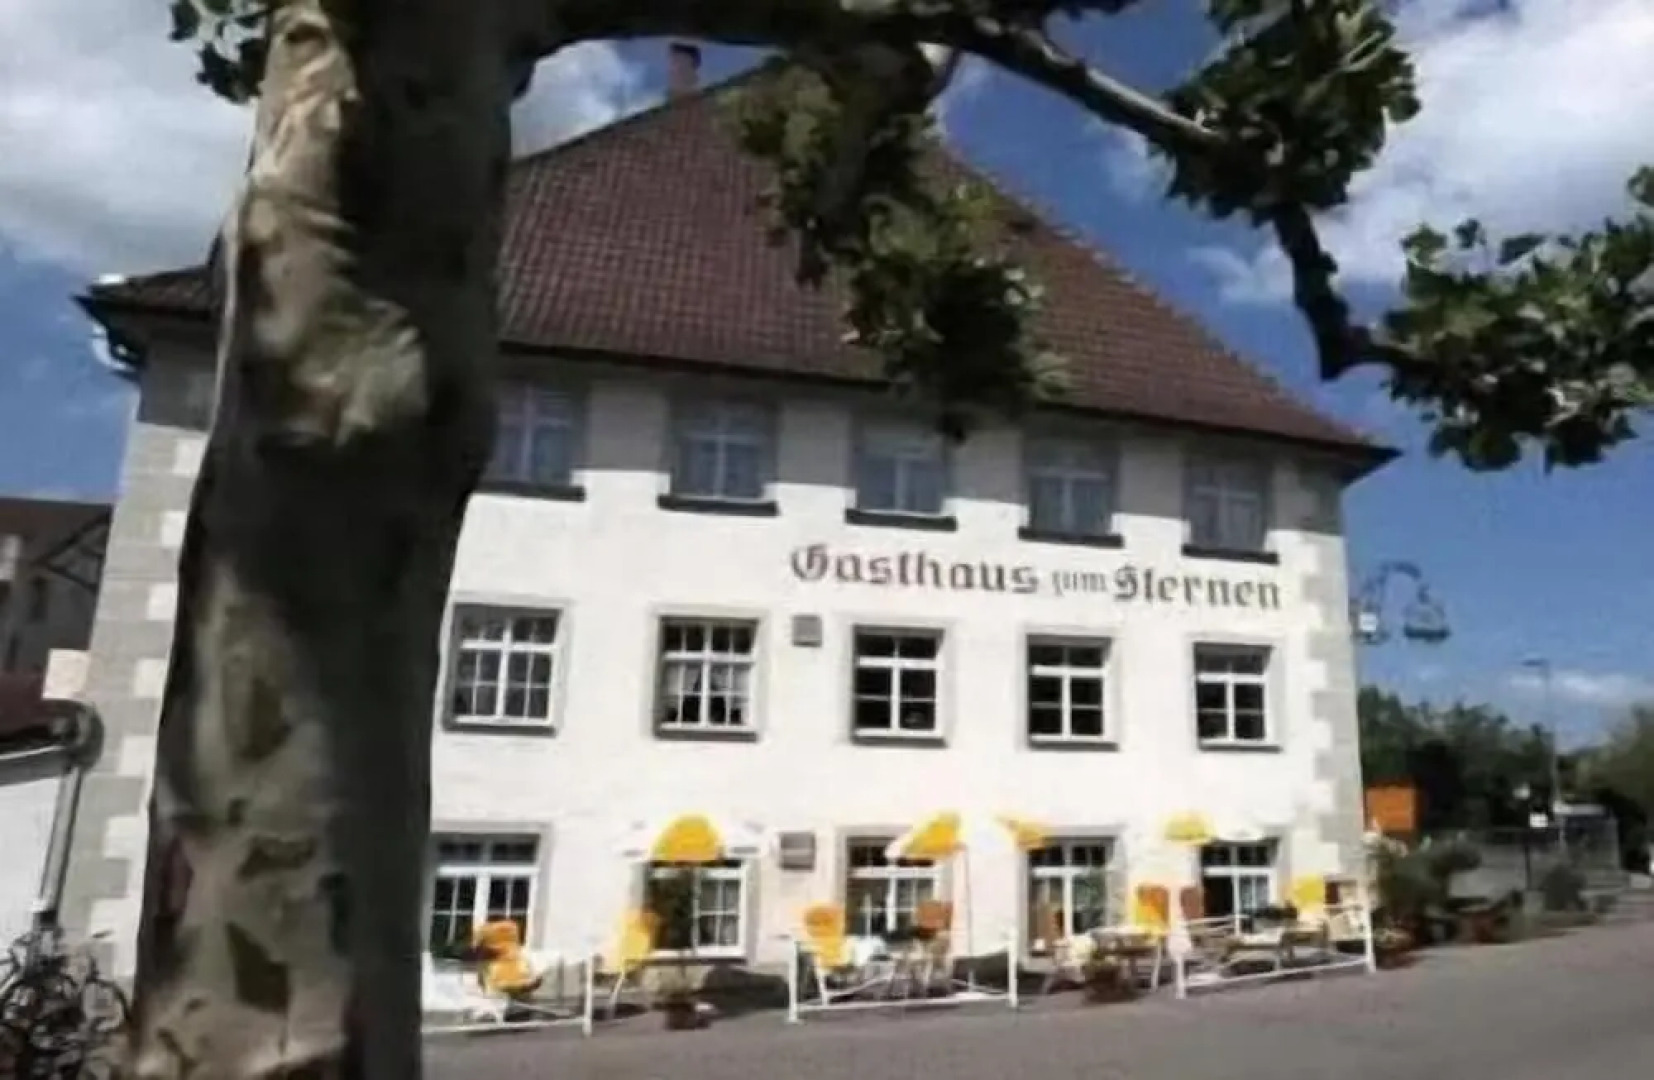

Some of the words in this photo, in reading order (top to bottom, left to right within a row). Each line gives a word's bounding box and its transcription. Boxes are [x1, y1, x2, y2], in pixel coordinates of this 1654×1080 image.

[791, 543, 1040, 594] Gasthaus
[1051, 570, 1108, 597] zum
[1114, 564, 1282, 610] Sternen
